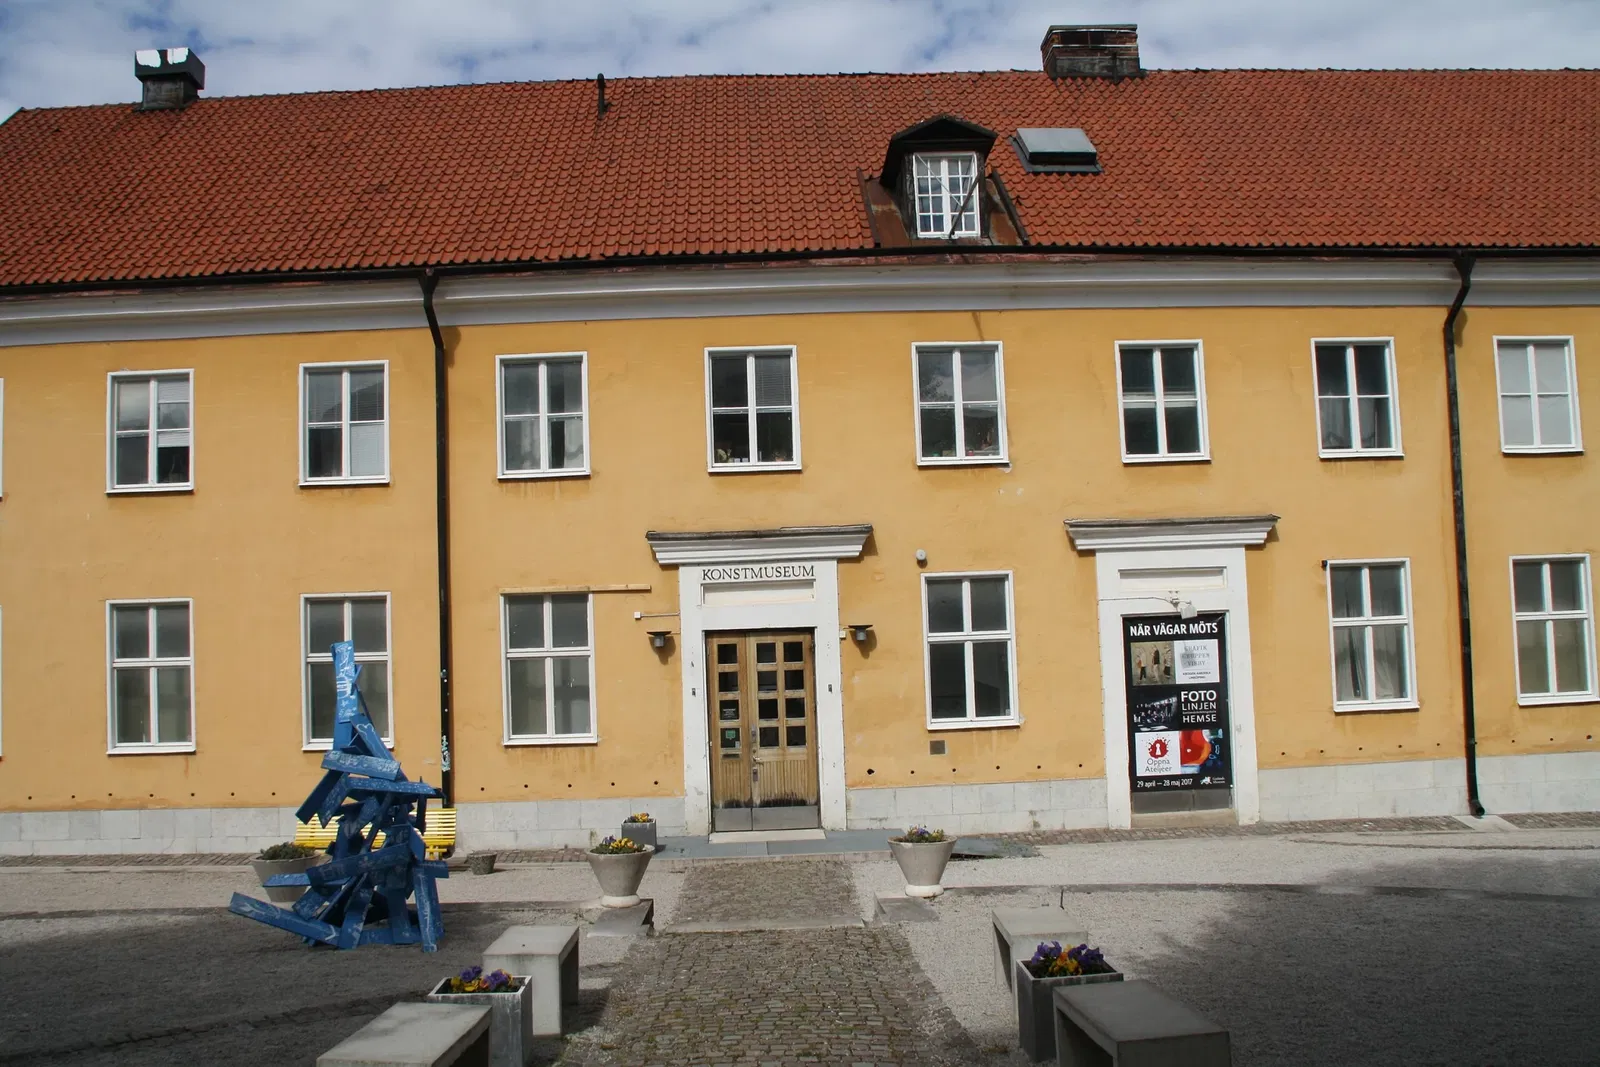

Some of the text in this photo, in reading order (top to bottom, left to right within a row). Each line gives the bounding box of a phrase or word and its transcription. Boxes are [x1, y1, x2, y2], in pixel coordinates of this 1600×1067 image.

[702, 565, 814, 580] KONSTMUSEUM
[1129, 621, 1218, 636] NÄR VÄGAR MÖTS
[1181, 690, 1217, 702] FOTO
[1182, 702, 1217, 710] LINJEN
[1182, 714, 1217, 723] HEMSE
[1137, 780, 1144, 788] 29
[1144, 780, 1156, 788] april
[1163, 779, 1170, 787] 28
[1171, 779, 1181, 787] maj
[1181, 778, 1193, 786] 2017
